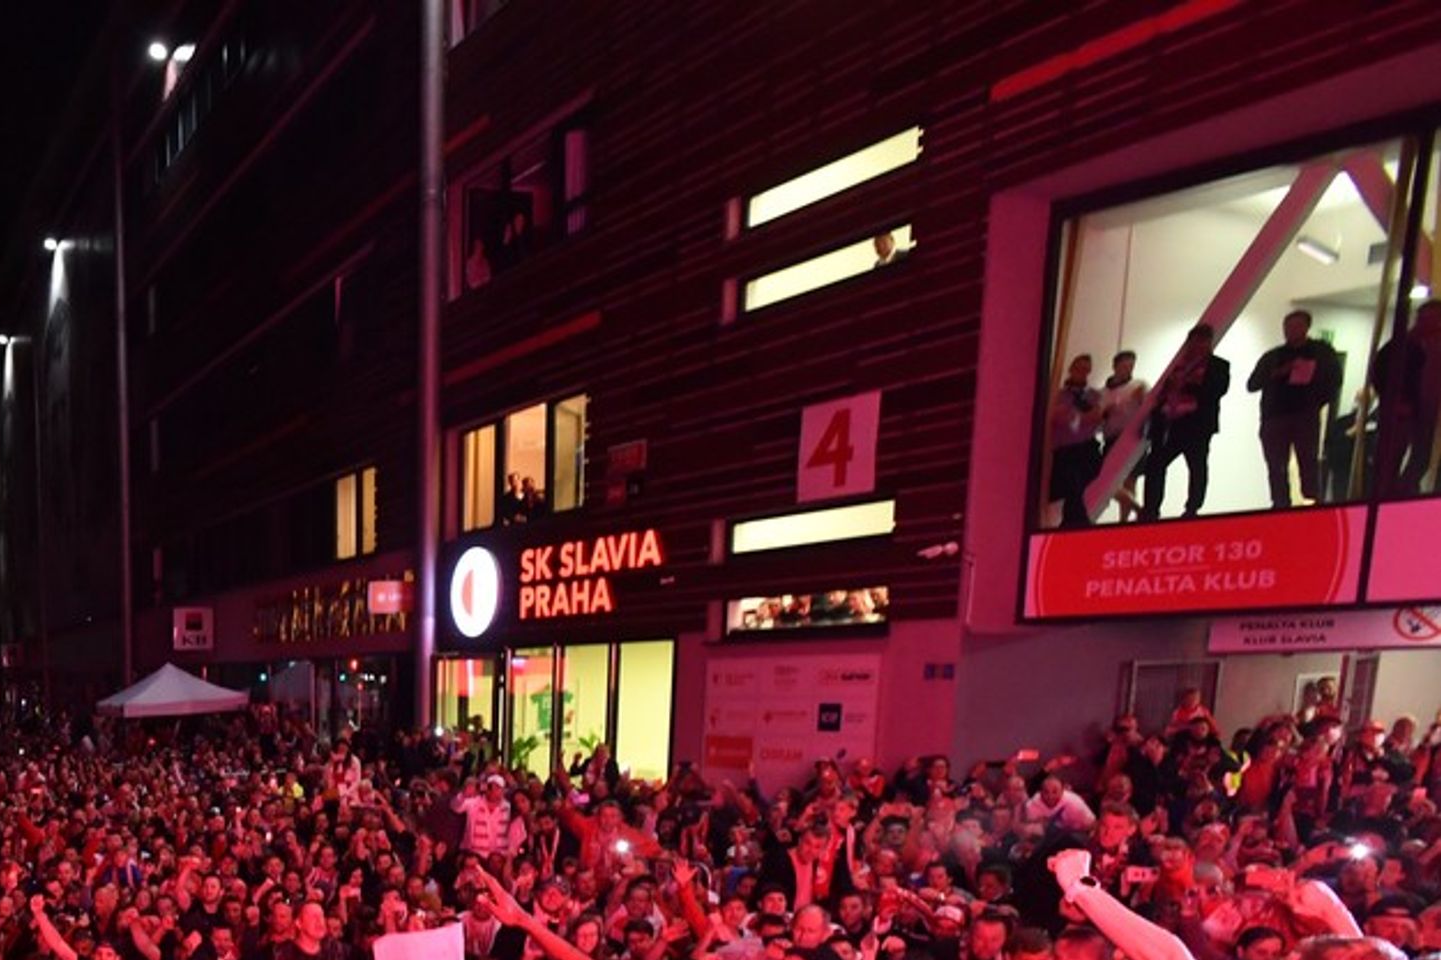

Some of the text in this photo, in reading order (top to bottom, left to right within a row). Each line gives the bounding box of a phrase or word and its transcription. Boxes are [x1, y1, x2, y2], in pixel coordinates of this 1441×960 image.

[806, 408, 854, 487] 4
[520, 528, 661, 582] SK SLAVIA
[1102, 539, 1262, 569] SEKTOR 130
[519, 577, 612, 619] PRAHA
[1085, 569, 1276, 597] PENALTA KLUB
[1239, 618, 1336, 630] PENALTA KLUB
